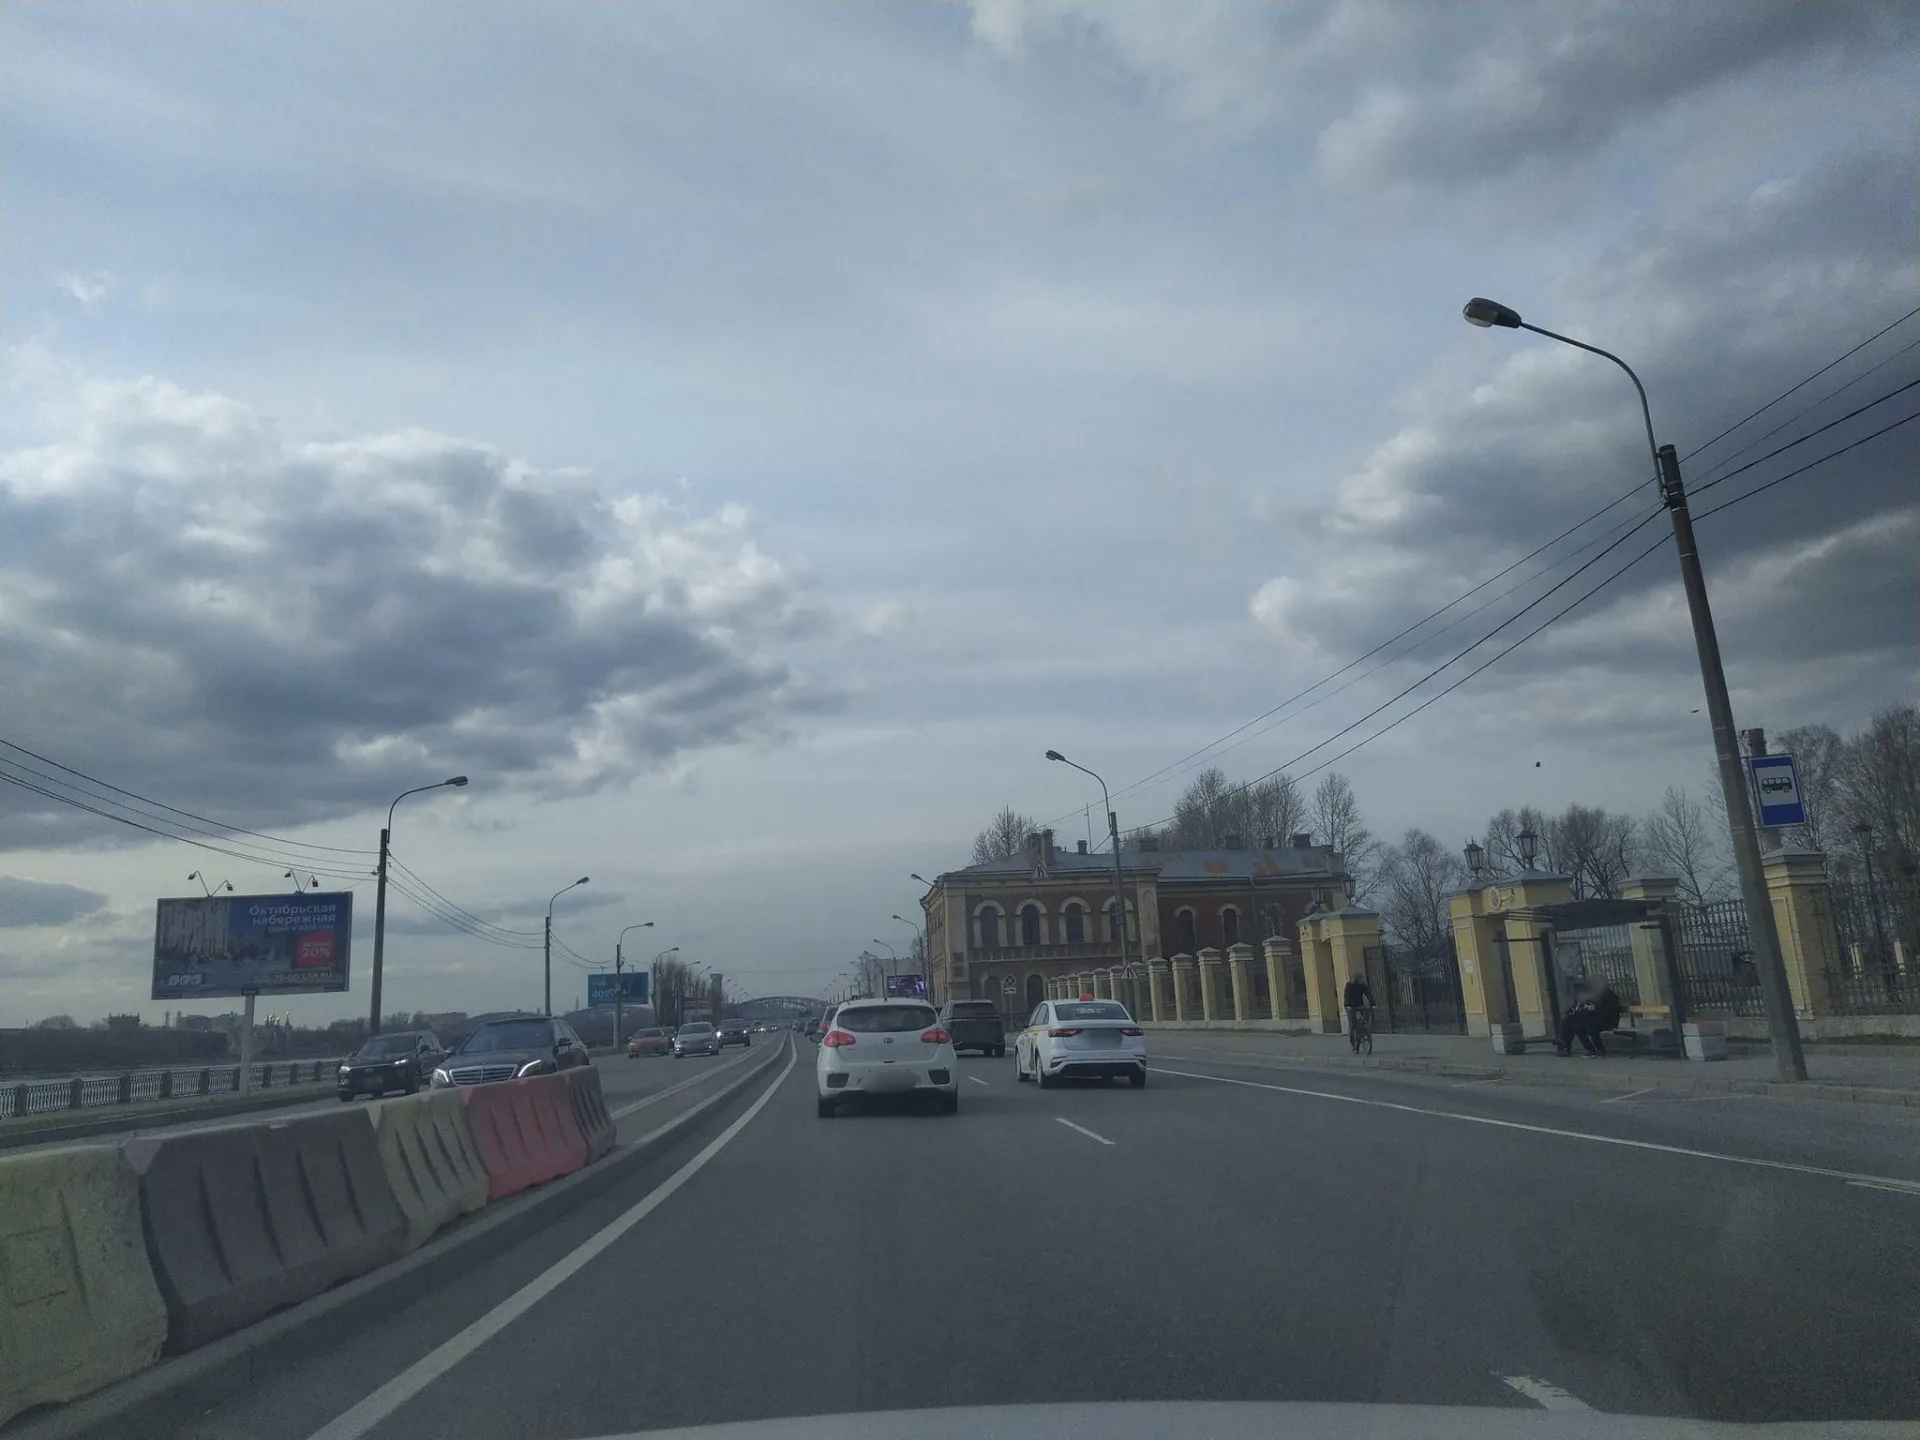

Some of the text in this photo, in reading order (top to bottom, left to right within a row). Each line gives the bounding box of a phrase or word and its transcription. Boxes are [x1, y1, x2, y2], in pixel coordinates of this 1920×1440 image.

[249, 904, 336, 916] Октябрьская
[252, 914, 336, 926] набережная
[301, 947, 330, 957] 20%
